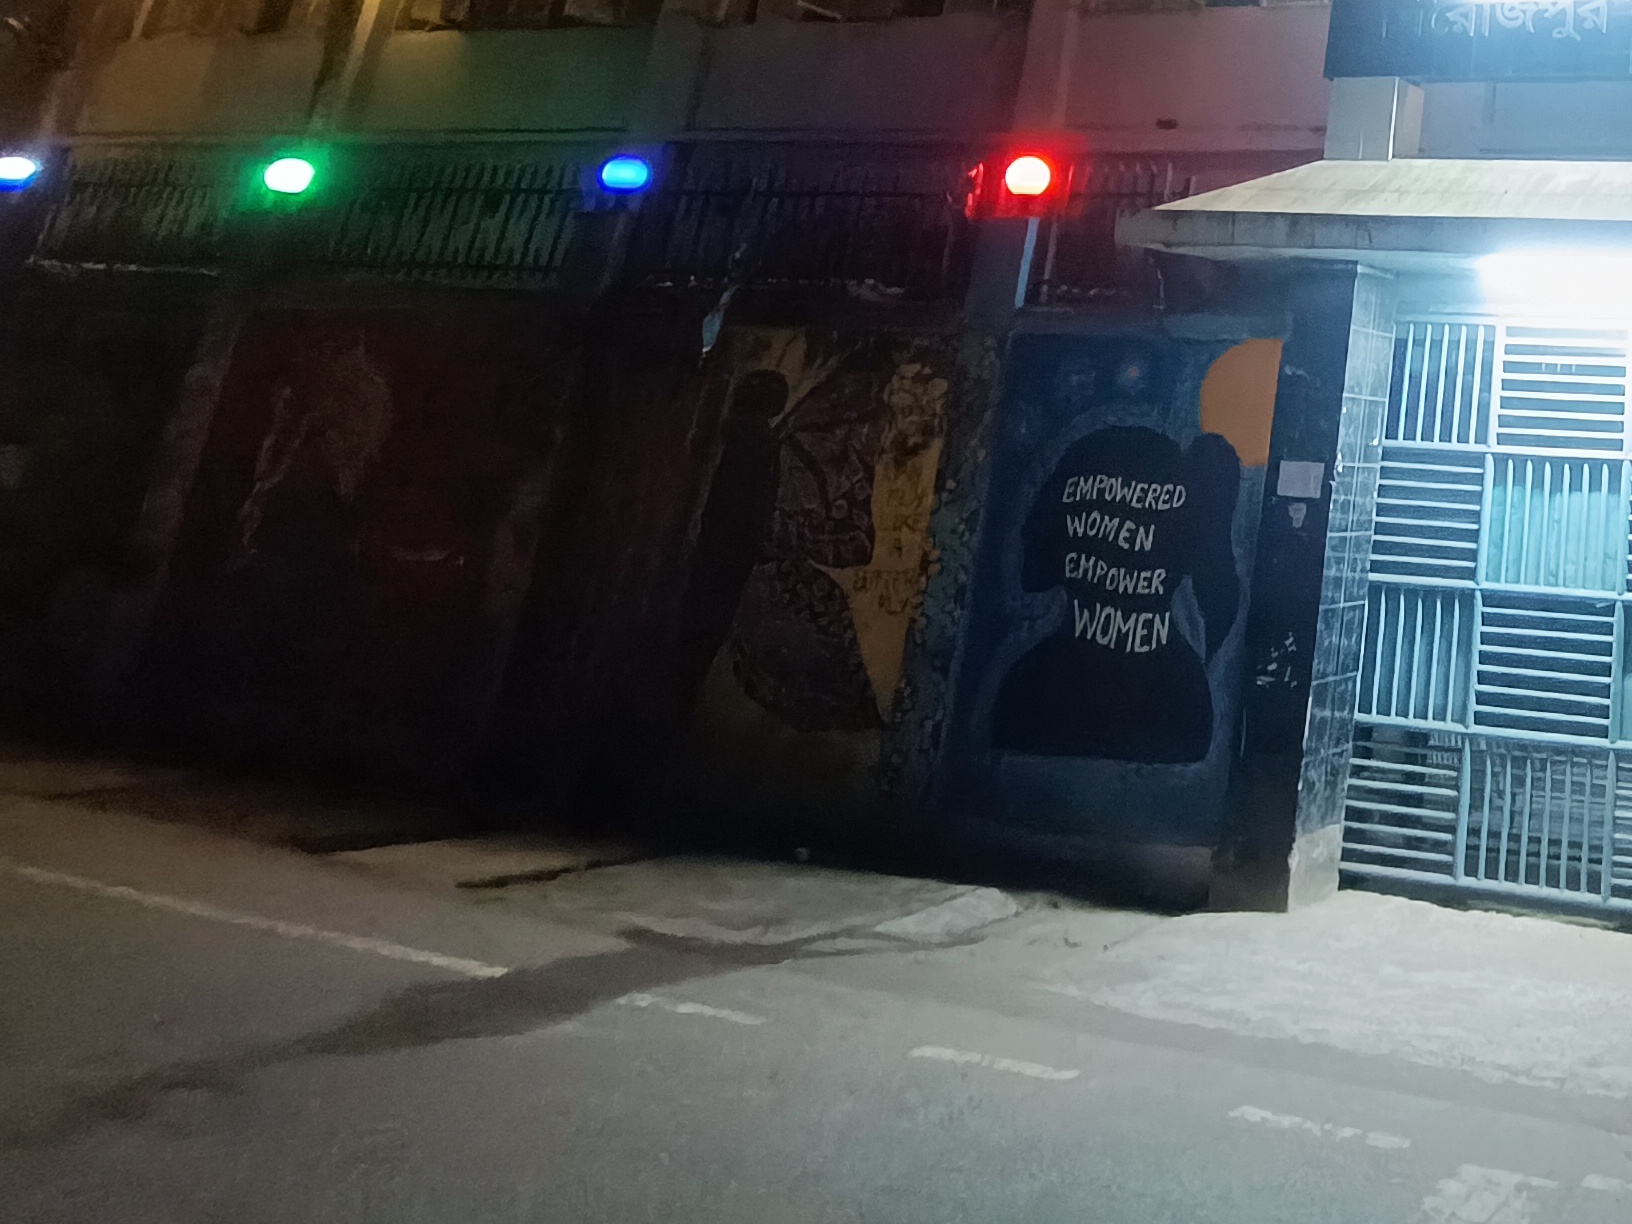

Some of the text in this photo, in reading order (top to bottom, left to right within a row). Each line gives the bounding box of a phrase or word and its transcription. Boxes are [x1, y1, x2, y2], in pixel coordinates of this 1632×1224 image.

[1062, 474, 1187, 510] EMPOWERED
[1066, 511, 1156, 551] WOMEN
[1064, 551, 1167, 596] EMPOWER
[1073, 598, 1170, 653] WOMEN
